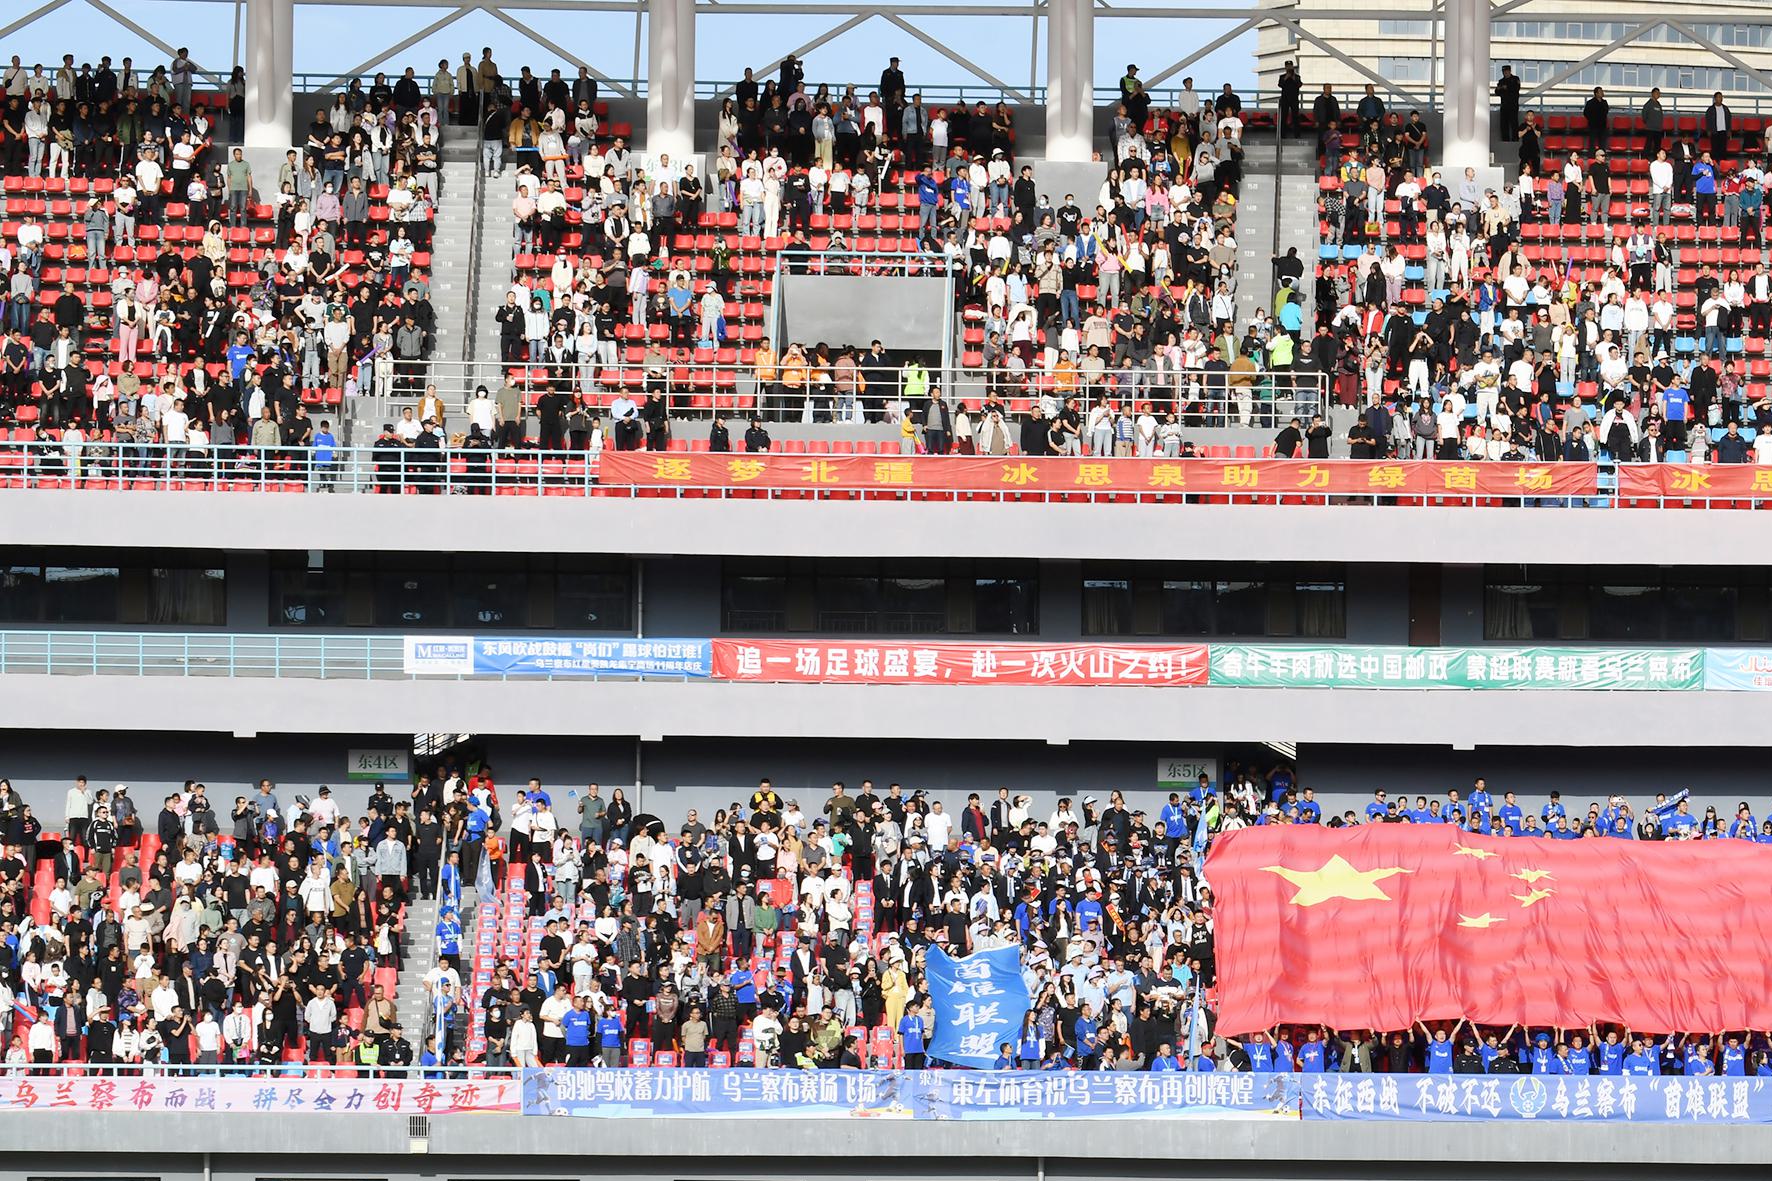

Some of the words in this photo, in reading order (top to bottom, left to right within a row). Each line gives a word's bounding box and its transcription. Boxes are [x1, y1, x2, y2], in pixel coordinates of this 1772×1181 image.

[653, 460, 914, 484] 逐梦北疆
[1001, 464, 1554, 490] 冰思泉助力绿茵场
[358, 753, 400, 770] 东4区
[1167, 762, 1208, 778] 东5区
[0, 1078, 507, 1113] 乌兰察布而战，拼尽全力创奇迹！
[557, 1070, 712, 1103] 韵驰驾校蓄力护航
[722, 1070, 877, 1104] 乌兰察布赛场飞扬
[1311, 1075, 1400, 1115] 东征西战
[1415, 1076, 1501, 1117] 不破不还
[1551, 1077, 1638, 1119] 乌兰察布
